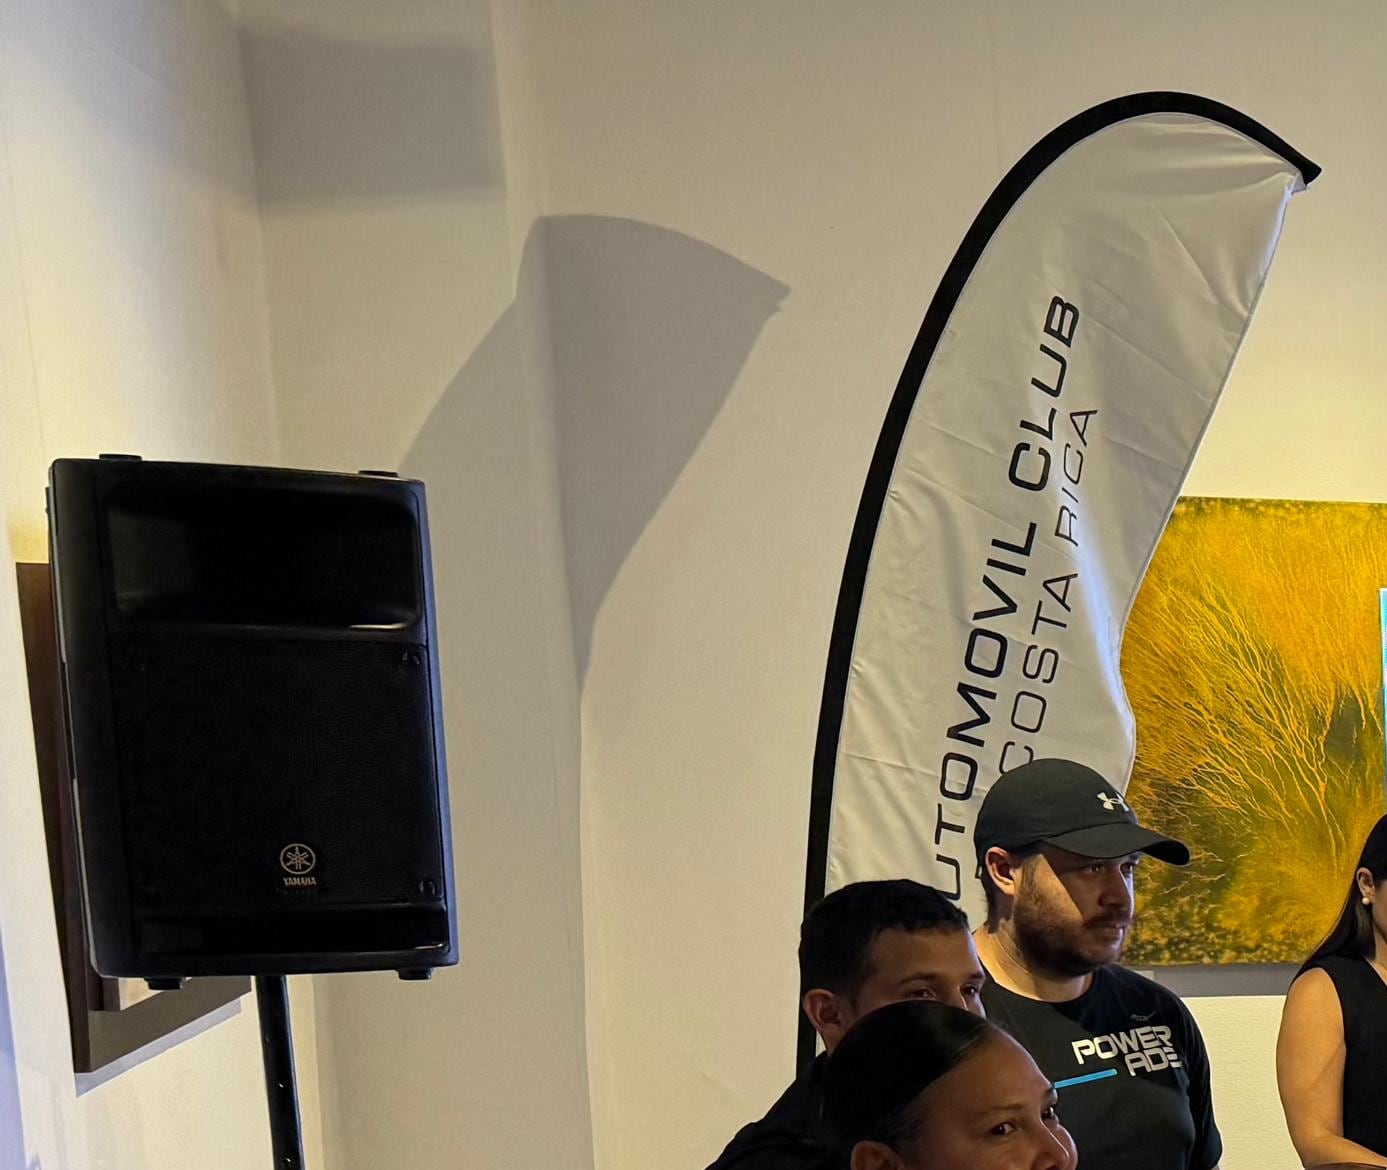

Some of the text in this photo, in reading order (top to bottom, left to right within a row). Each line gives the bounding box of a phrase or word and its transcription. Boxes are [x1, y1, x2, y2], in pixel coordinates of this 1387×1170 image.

[1055, 409, 1098, 547] RICA
[934, 295, 1080, 900] UTOMOVIL CLUB
[1071, 1025, 1173, 1065] POWER
